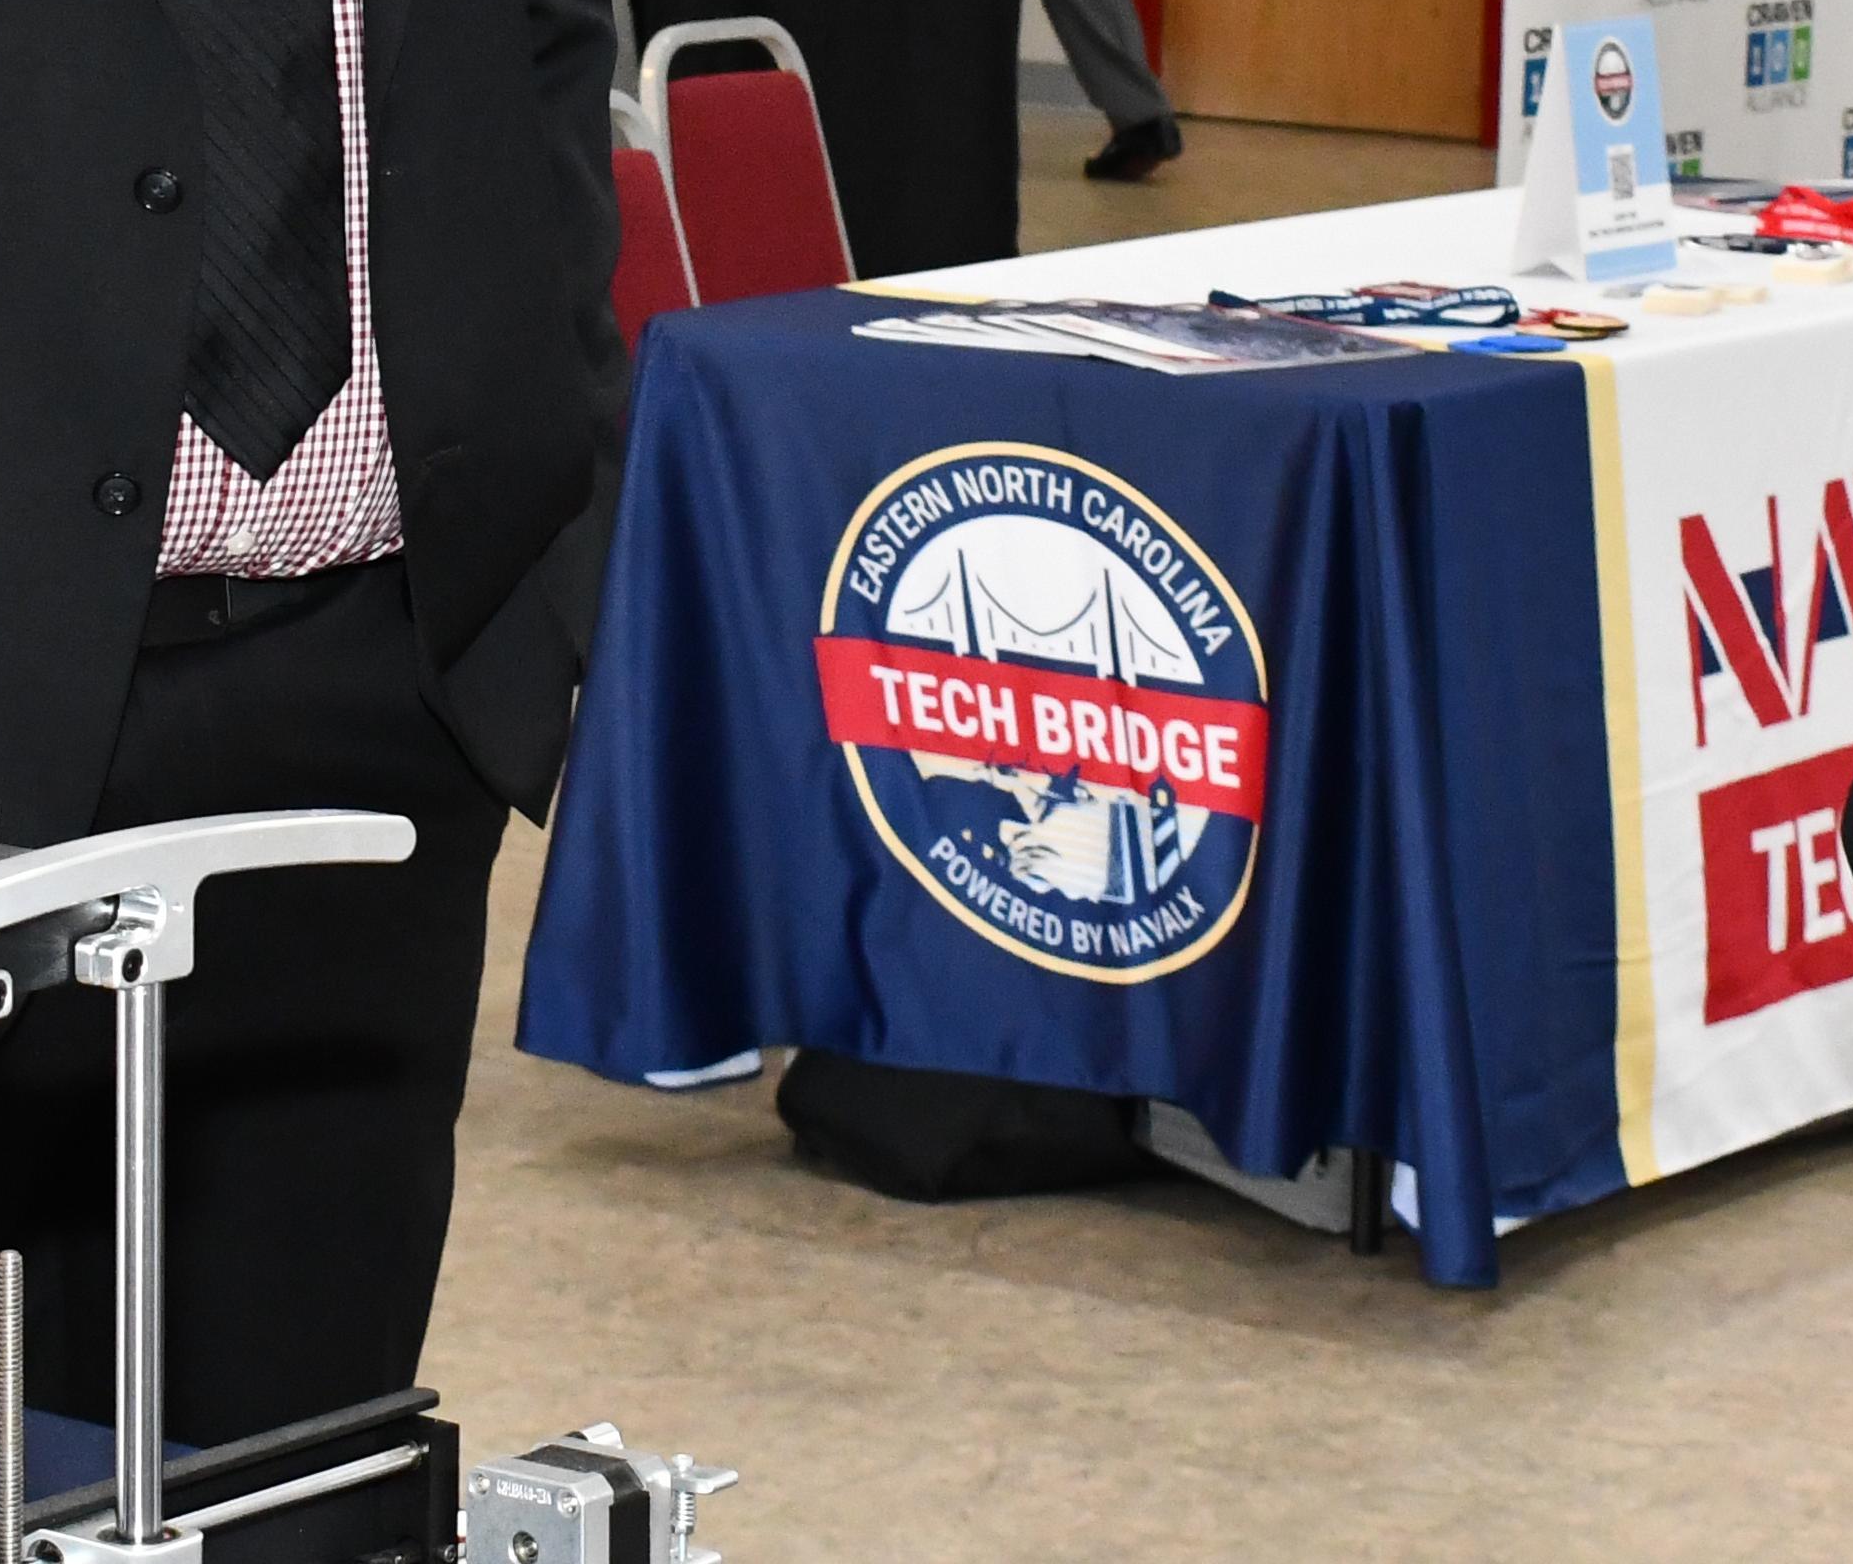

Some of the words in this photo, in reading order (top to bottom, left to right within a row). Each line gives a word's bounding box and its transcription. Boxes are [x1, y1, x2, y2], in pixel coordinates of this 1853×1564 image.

[1748, 0, 1813, 26] CRAVEN
[850, 478, 952, 604] EASTERN
[952, 465, 1072, 514] NORTH
[1082, 489, 1233, 656] CAROLINA
[870, 663, 1019, 748] TECH
[1033, 693, 1241, 788] BRIDGE
[928, 836, 1063, 948] POWERED
[1072, 919, 1105, 956] BY
[1108, 885, 1206, 958] NAVALX
